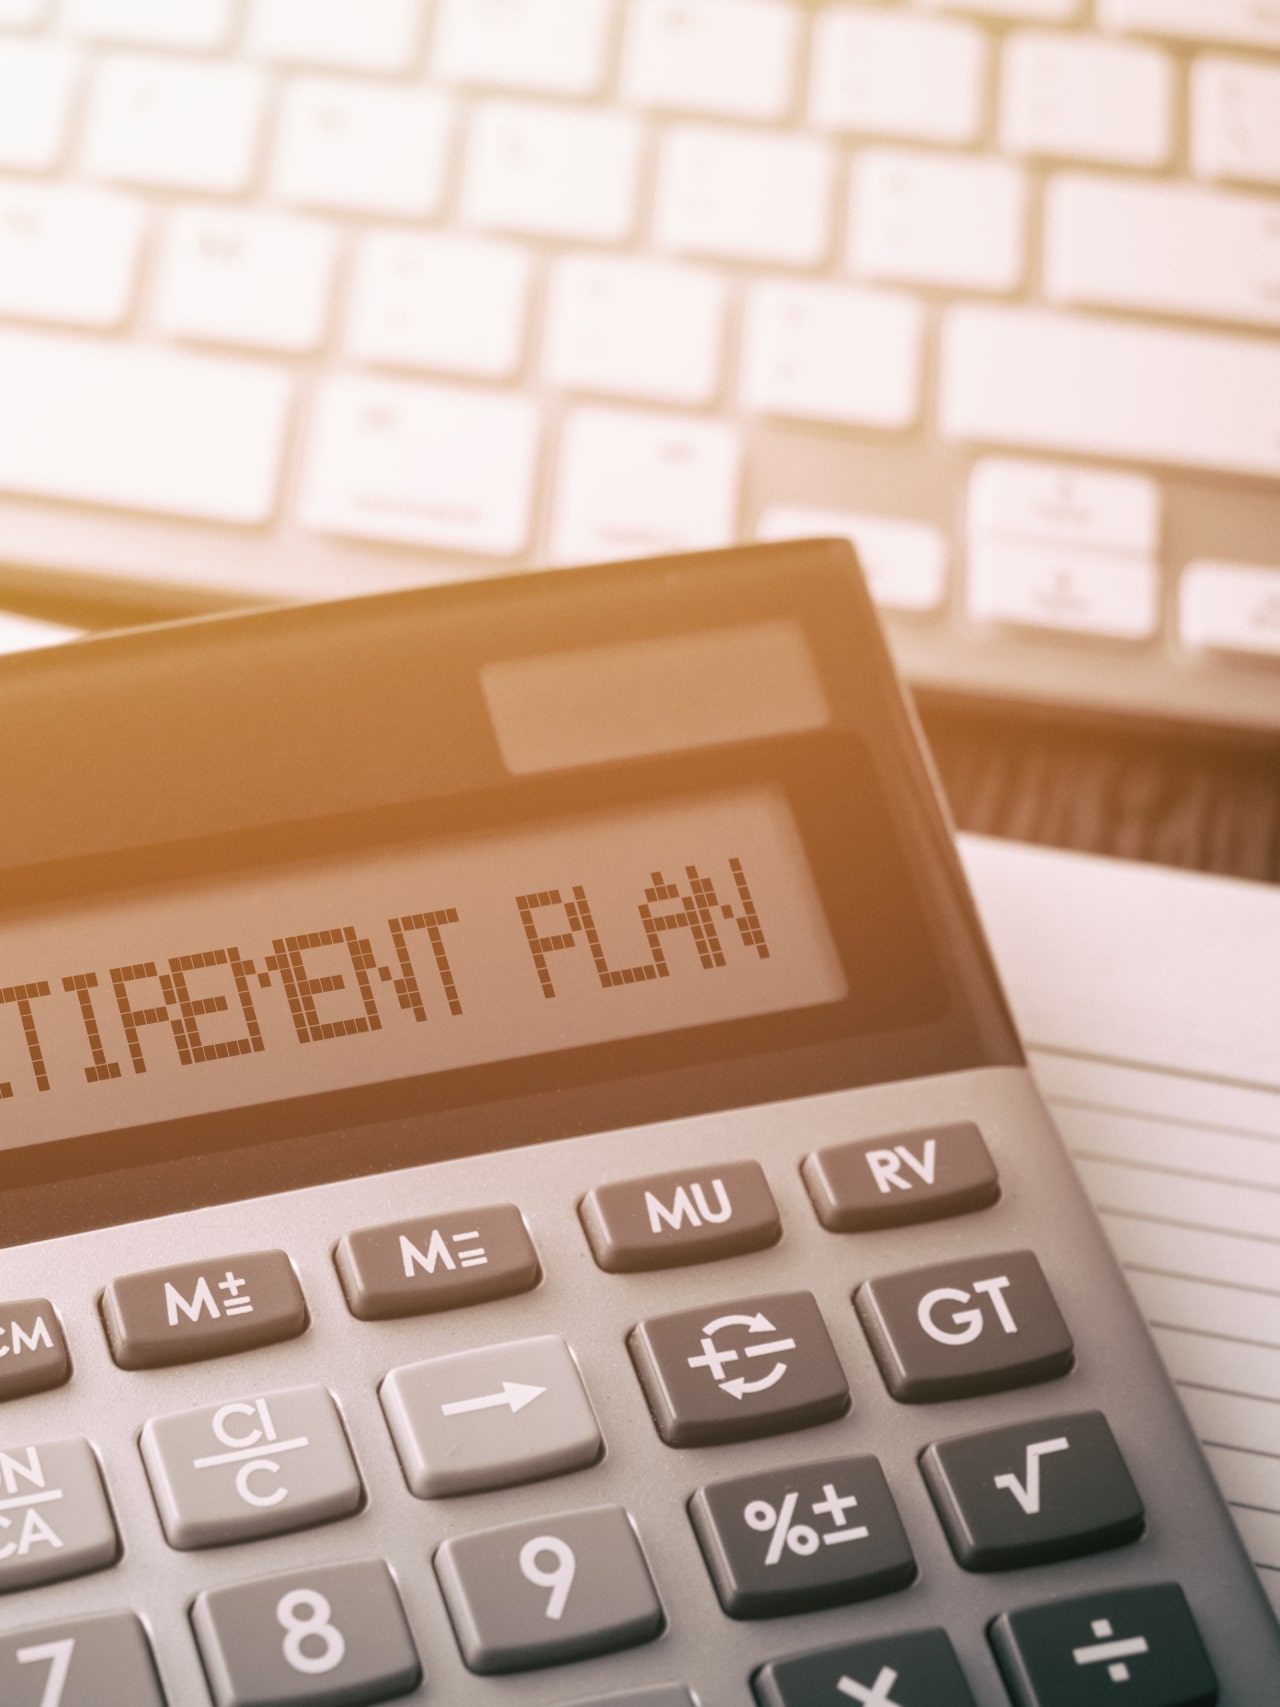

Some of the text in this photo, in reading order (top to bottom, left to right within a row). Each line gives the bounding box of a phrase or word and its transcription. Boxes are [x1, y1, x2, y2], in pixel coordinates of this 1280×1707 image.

[516, 858, 769, 998] PLAN
[866, 1140, 936, 1193] RV
[645, 1179, 732, 1233] MU
[918, 1276, 1017, 1345] GT
[236, 1460, 288, 1507] C
[520, 1536, 575, 1620] 9
[277, 1589, 344, 1673] 8
[17, 1639, 74, 1707] 7
